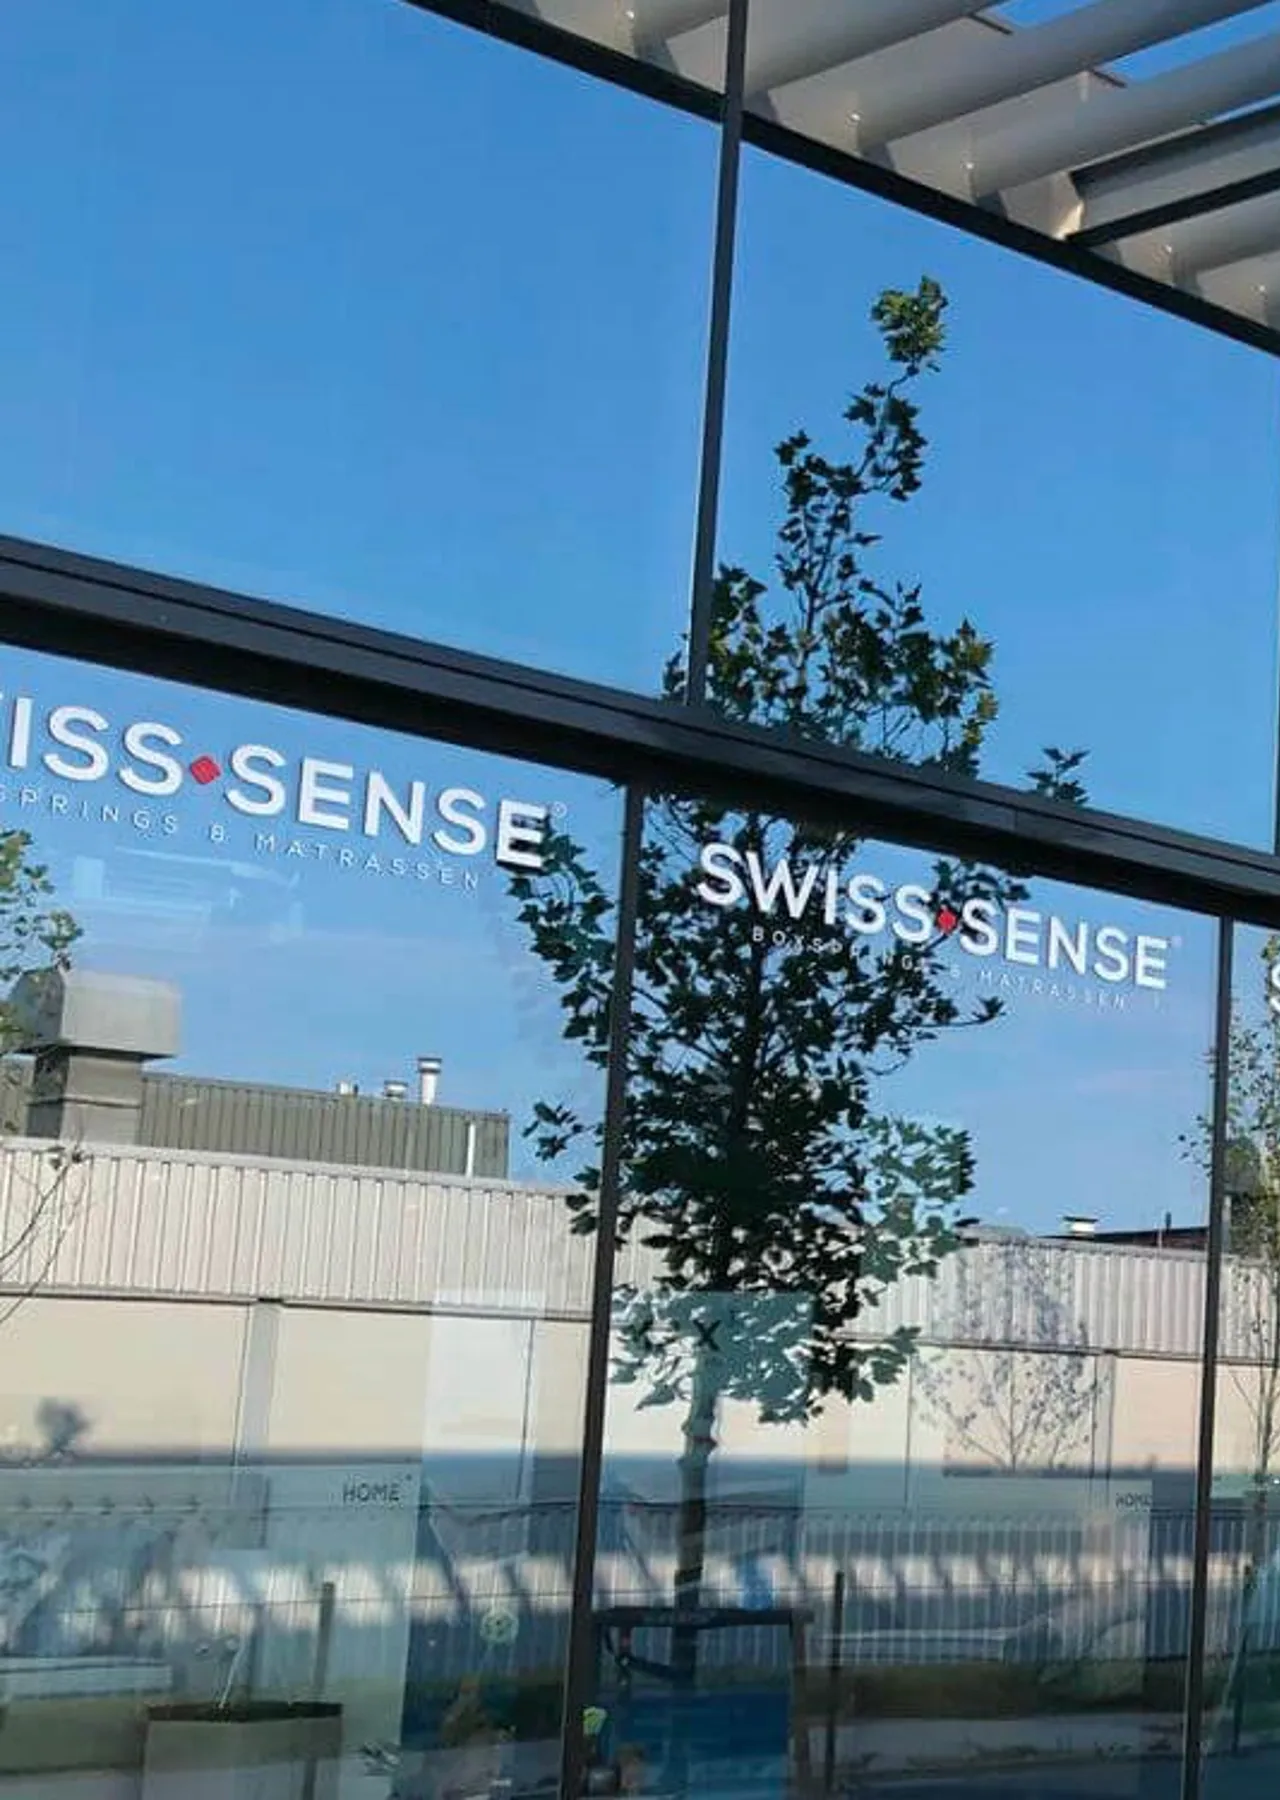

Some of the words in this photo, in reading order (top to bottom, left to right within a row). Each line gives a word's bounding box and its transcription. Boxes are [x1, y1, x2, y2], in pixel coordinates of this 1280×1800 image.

[0, 691, 184, 796] ISS
[256, 833, 479, 889] MATRASSEN
[697, 841, 933, 943] SWISS
[342, 1482, 400, 1503] HOME
